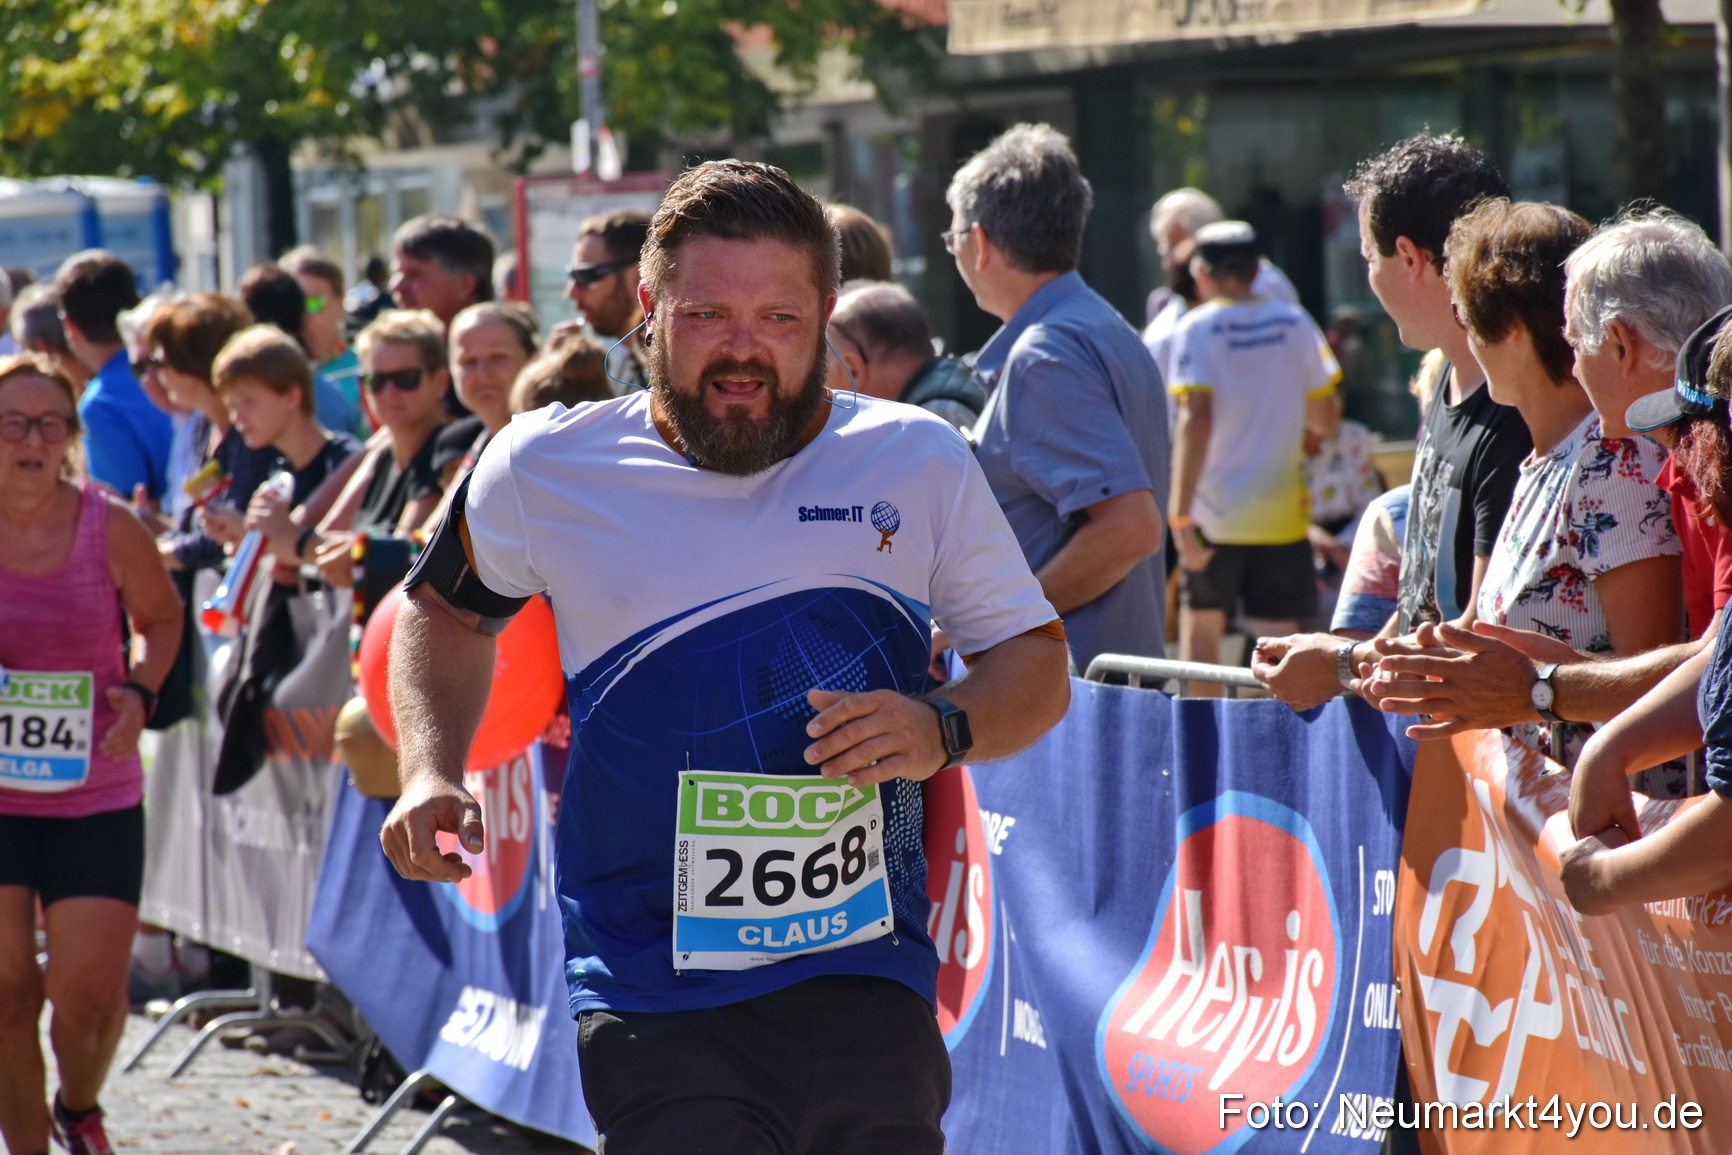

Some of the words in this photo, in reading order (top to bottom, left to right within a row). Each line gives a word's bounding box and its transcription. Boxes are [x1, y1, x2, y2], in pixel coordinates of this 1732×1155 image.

[798, 505, 864, 522] Schmer.IT
[870, 819, 877, 831] D
[978, 810, 1015, 856] ORE
[705, 825, 867, 906] 2668
[738, 910, 848, 947] CLAUS
[1638, 928, 1661, 966] für
[1663, 934, 1687, 971] die
[1121, 884, 1324, 1091] Hervis
[1565, 972, 1648, 1076] CLINIC
[1124, 1053, 1204, 1104] SPORTS
